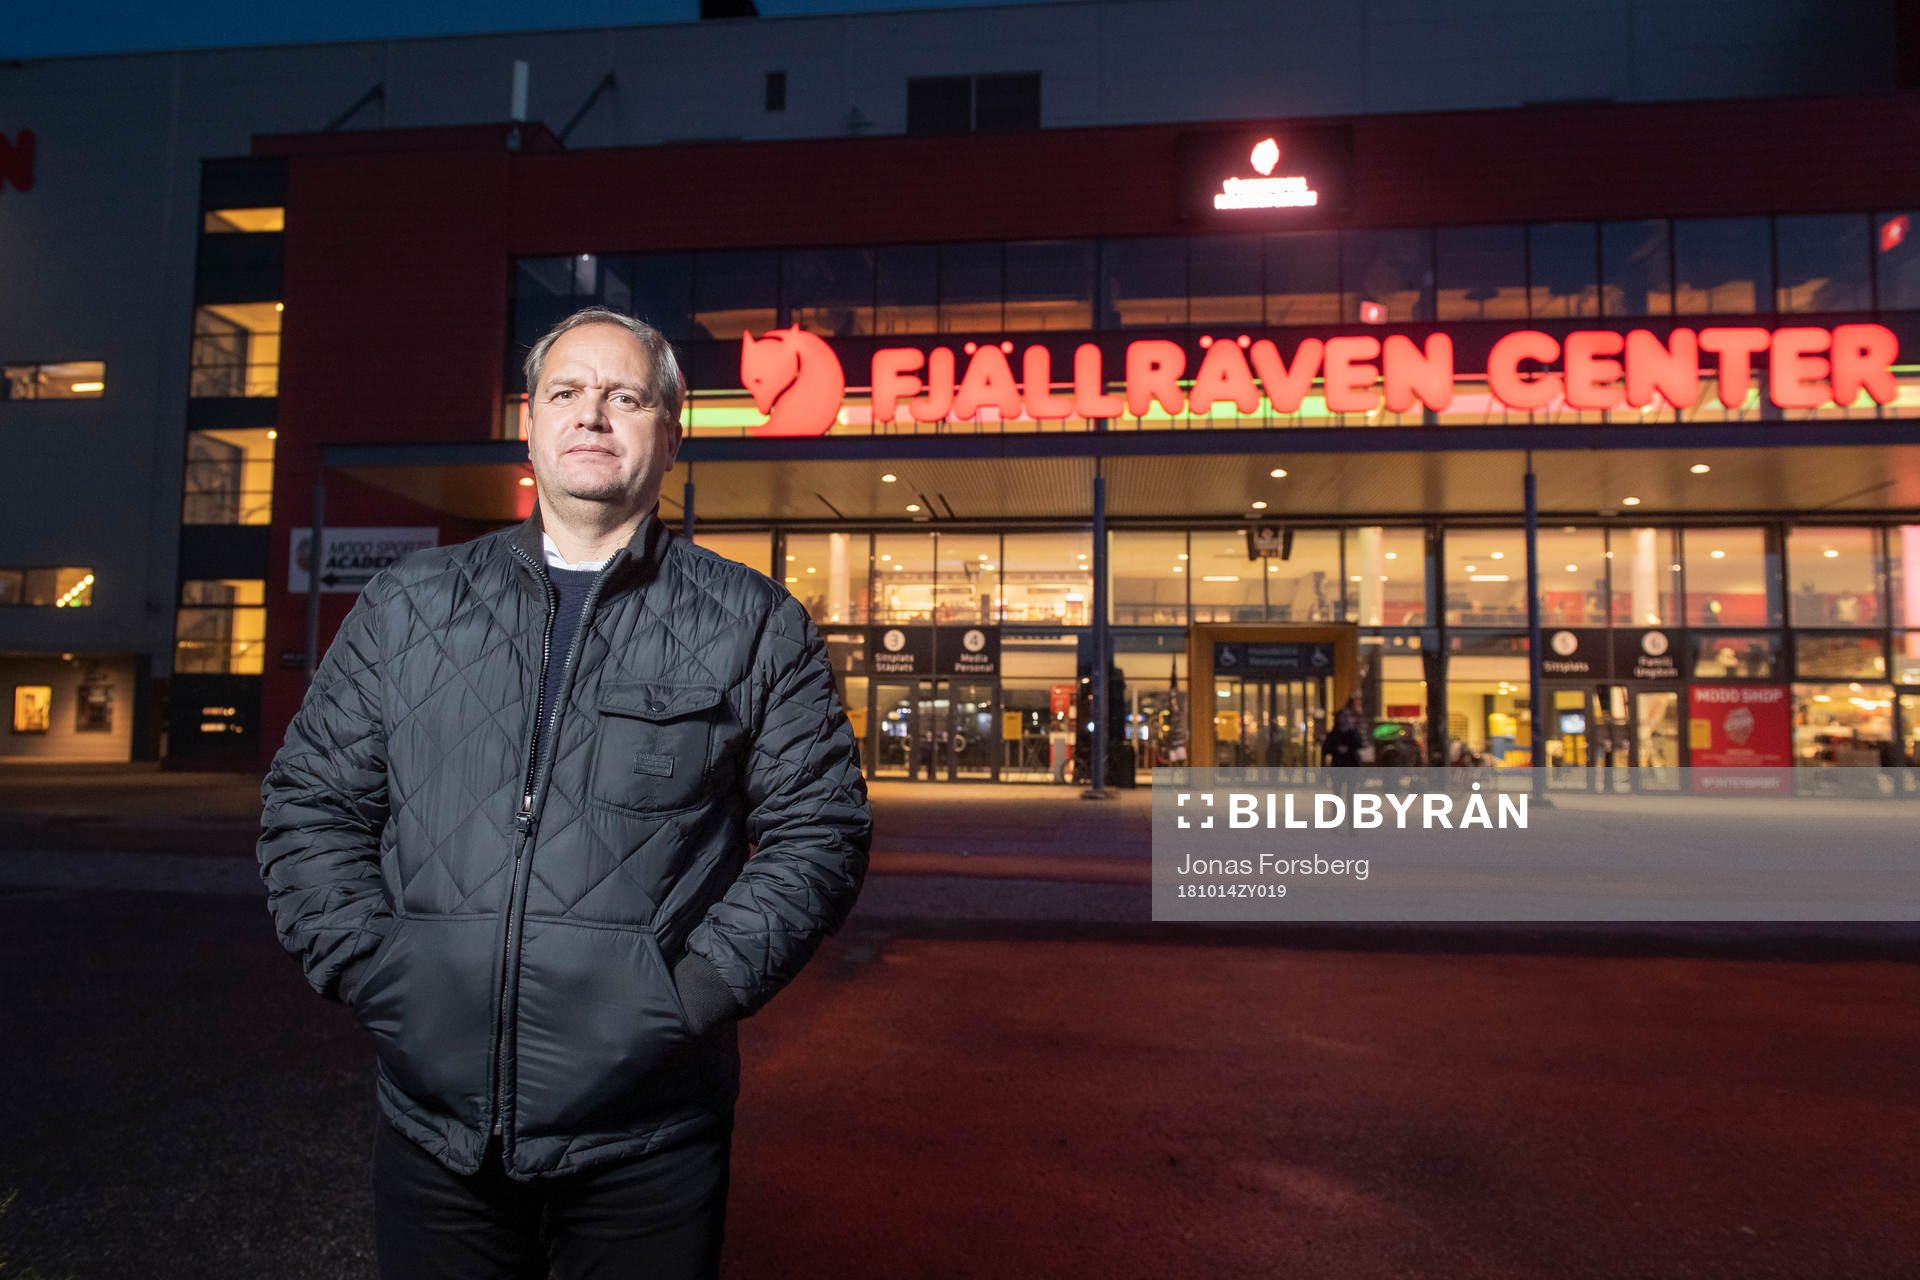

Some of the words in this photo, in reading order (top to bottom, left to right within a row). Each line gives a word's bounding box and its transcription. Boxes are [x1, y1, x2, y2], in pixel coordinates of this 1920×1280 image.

[871, 334, 1454, 421] FJÄLLRÄVEN
[1487, 323, 1900, 409] CENTER
[326, 556, 398, 568] ACADEM
[960, 653, 989, 662] Media
[954, 663, 994, 672] Personal
[1695, 688, 1739, 703] MODO
[1741, 688, 1783, 703] SHOP
